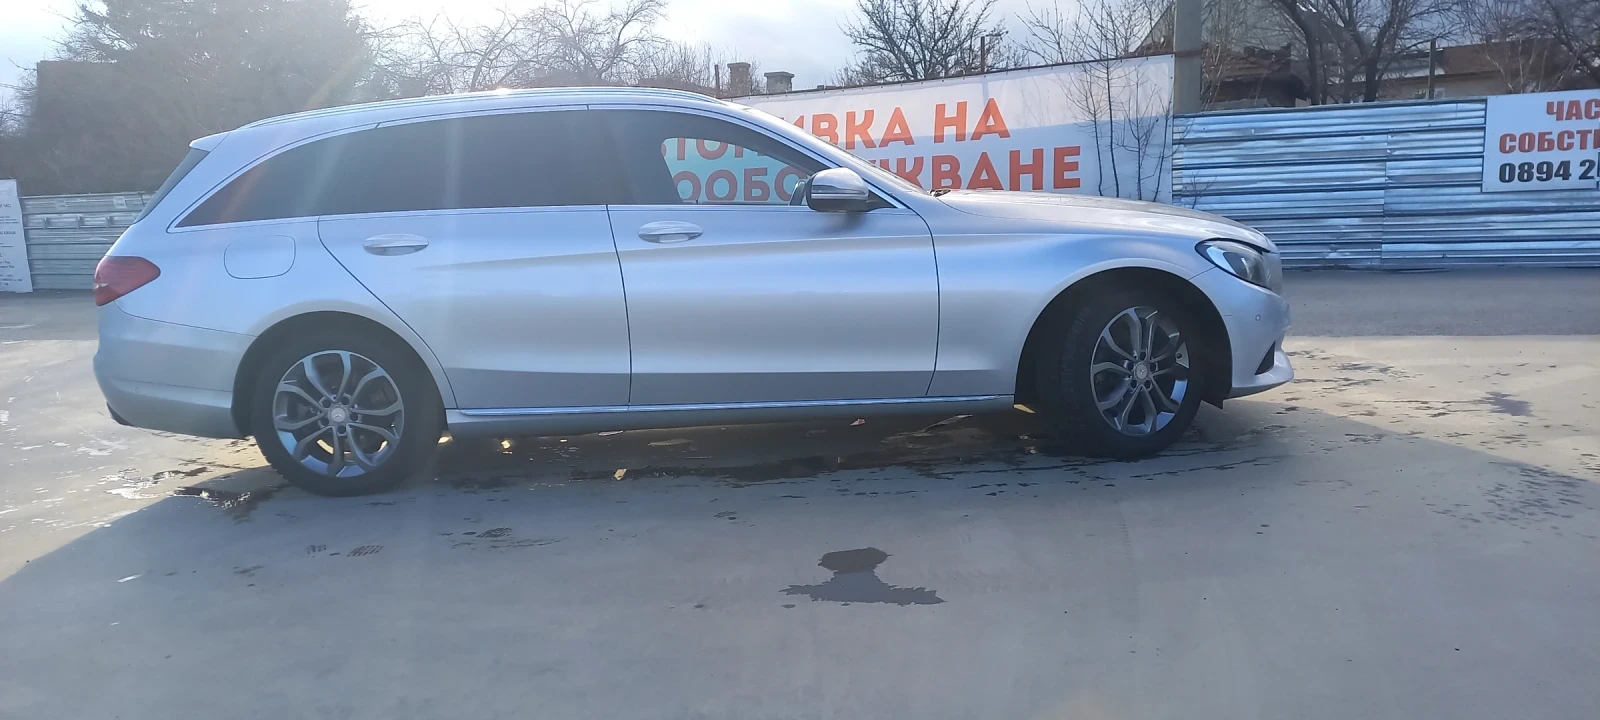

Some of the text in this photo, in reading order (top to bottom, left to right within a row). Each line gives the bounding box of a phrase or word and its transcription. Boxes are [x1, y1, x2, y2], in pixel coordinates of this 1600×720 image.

[934, 98, 1011, 143] НА
[1499, 159, 1597, 183] 0894 2
